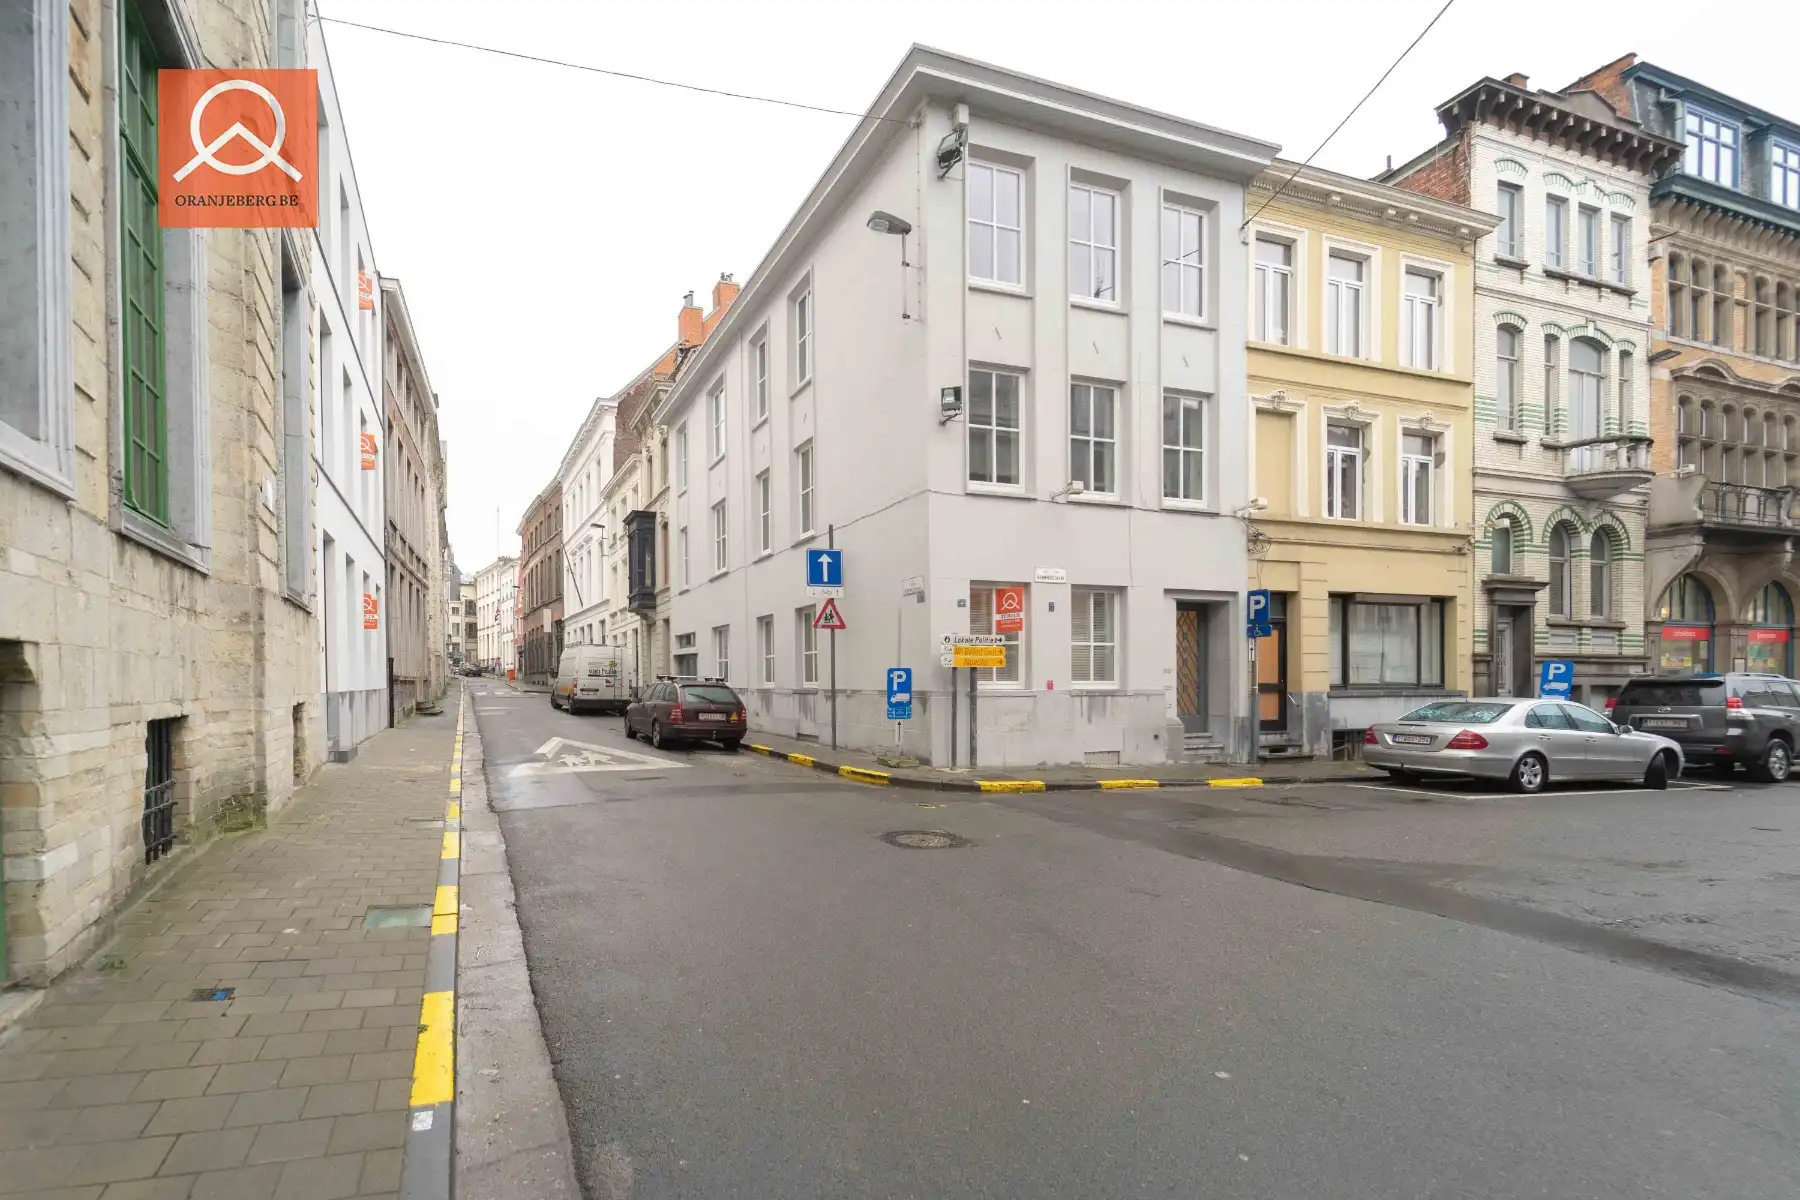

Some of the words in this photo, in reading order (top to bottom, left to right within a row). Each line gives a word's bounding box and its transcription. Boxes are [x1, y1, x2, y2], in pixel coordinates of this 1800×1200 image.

[1249, 595, 1266, 620] P
[893, 670, 907, 690] P
[1547, 663, 1566, 680] P
